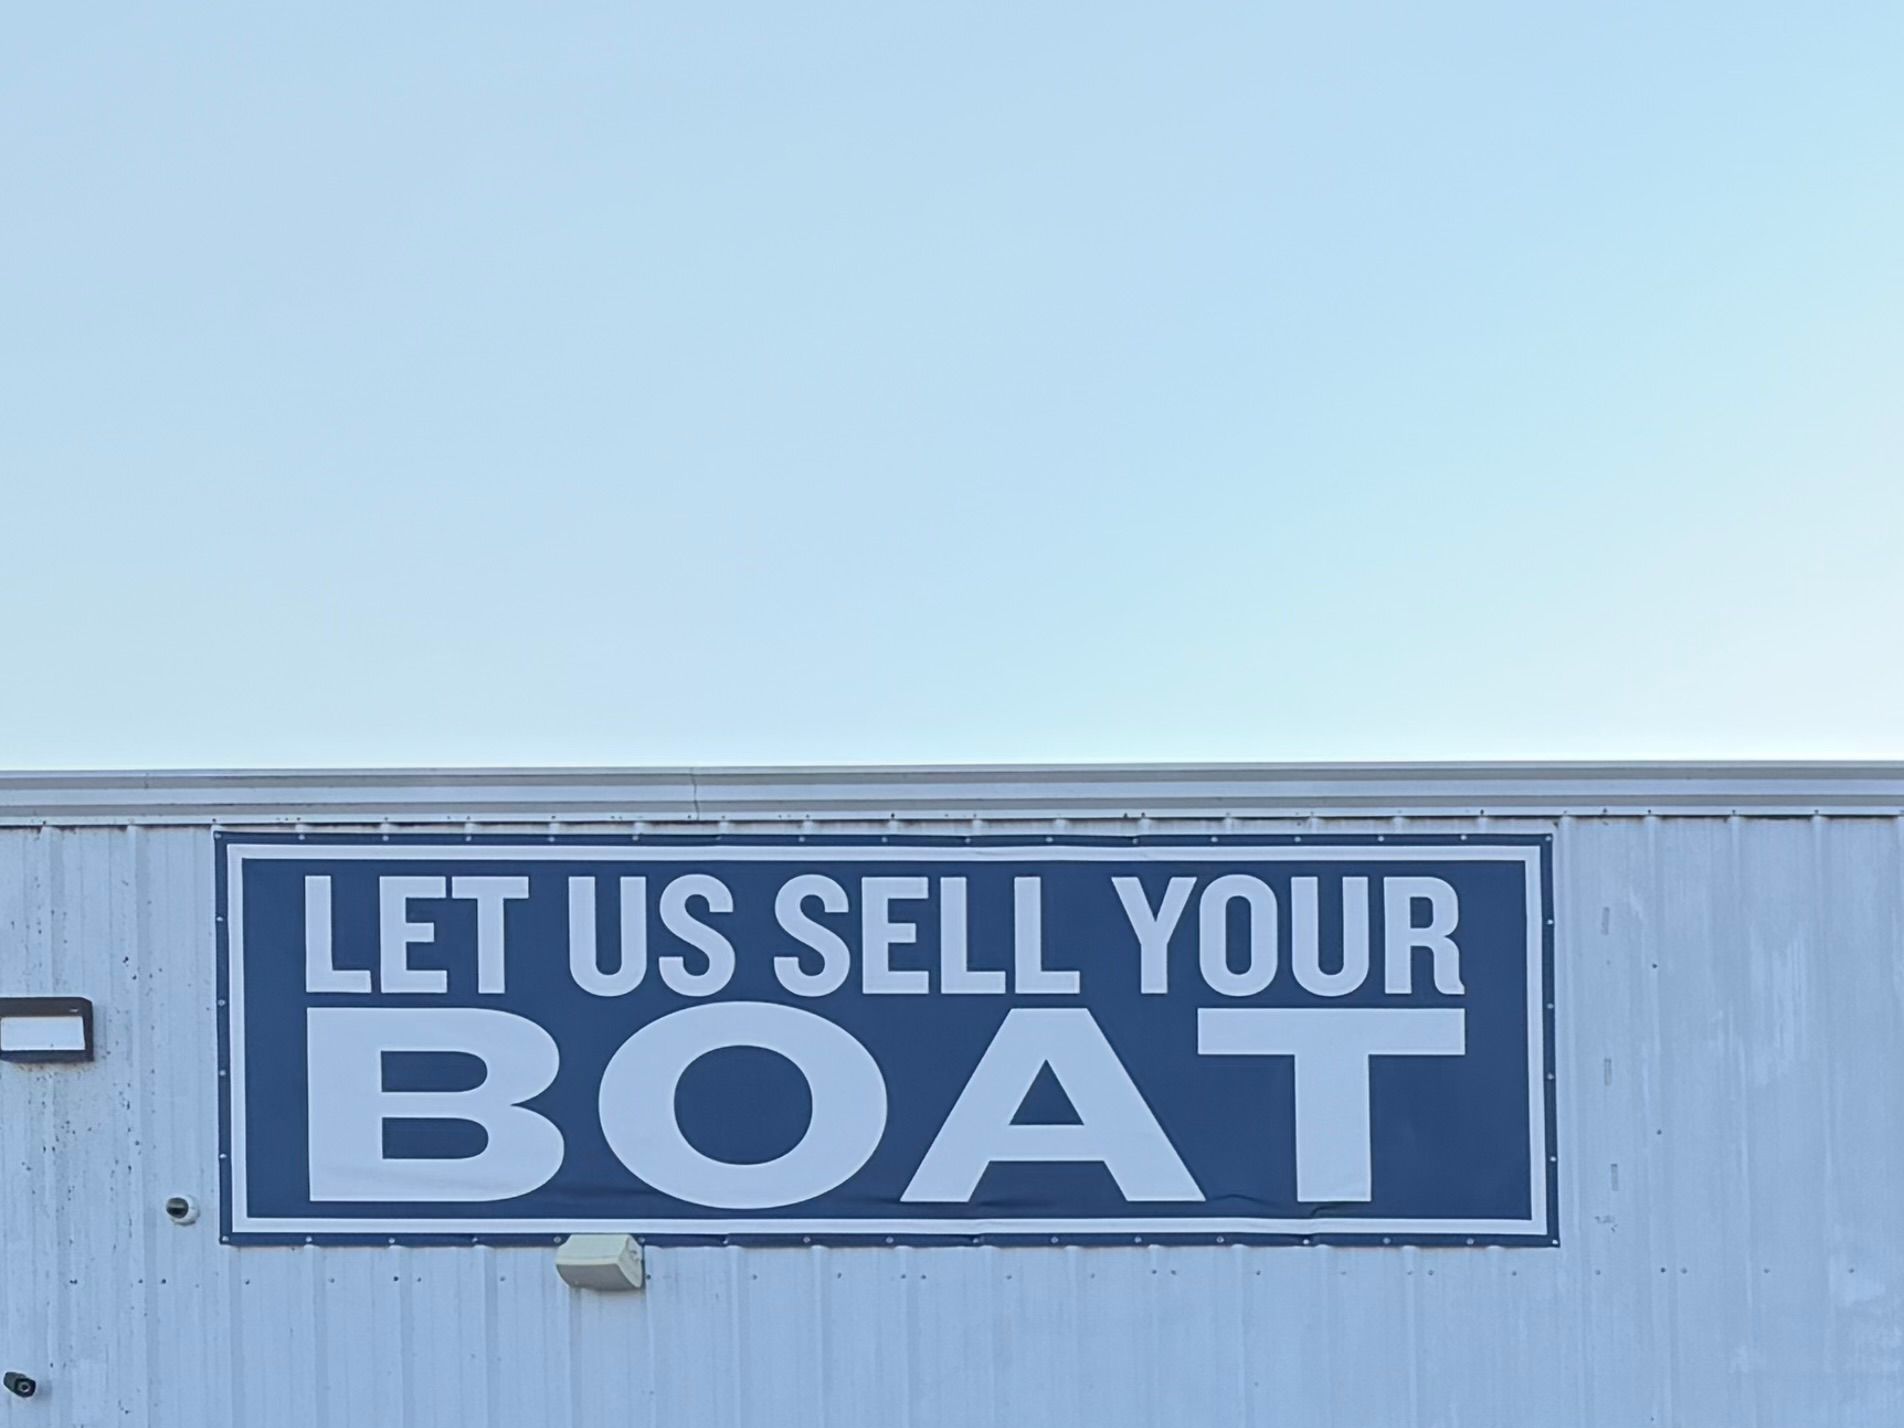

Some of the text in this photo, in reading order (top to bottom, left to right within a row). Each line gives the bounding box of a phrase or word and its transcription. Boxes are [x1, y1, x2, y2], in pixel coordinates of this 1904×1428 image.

[305, 873, 1467, 996] LET US SELL YOUR
[307, 1001, 1467, 1210] BOAT
